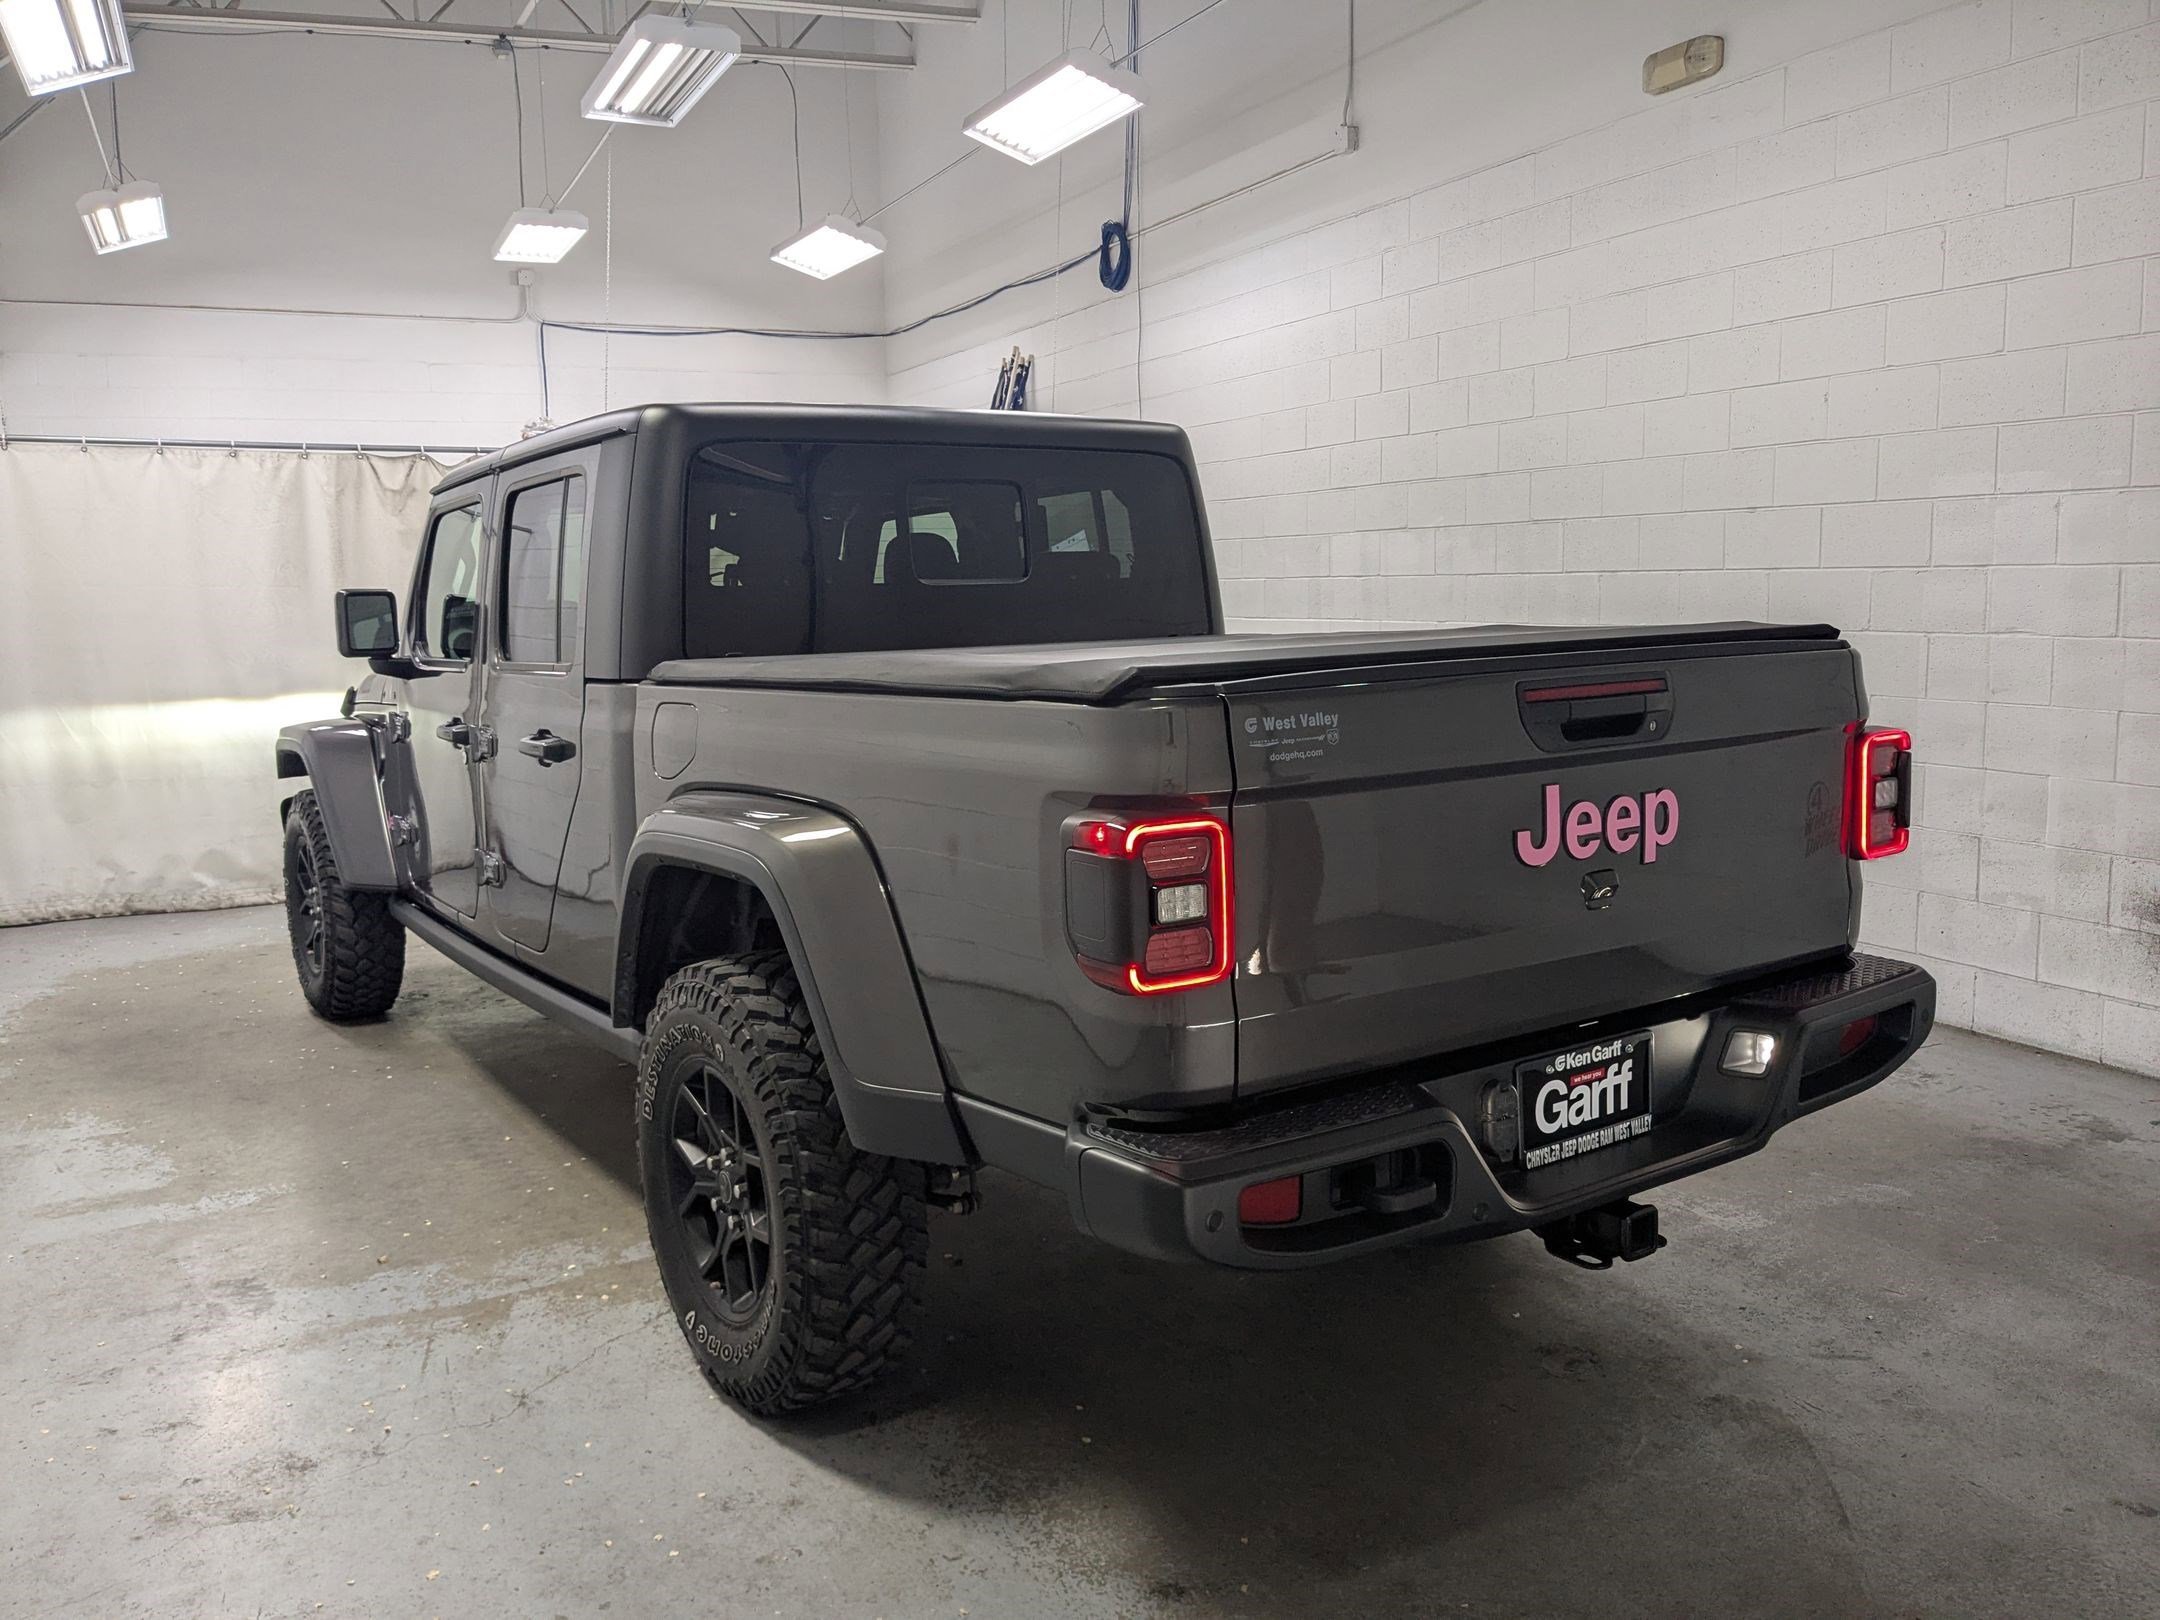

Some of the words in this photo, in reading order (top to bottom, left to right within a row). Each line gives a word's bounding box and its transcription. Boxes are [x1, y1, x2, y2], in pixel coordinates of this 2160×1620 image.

[1262, 715, 1296, 731] West
[1299, 712, 1338, 727] Valley
[1269, 749, 1324, 761] dodgehq.com
[1514, 783, 1680, 867] Jeep
[642, 1023, 714, 1121] DESTINATION
[1566, 1051, 1591, 1070] Ken
[1591, 1039, 1623, 1062] Garff
[1535, 1059, 1632, 1134] Garff
[1573, 1075, 1582, 1083] we
[1581, 1072, 1593, 1081] hear
[1592, 1070, 1602, 1079] you
[1526, 1144, 1561, 1169] CHRYSLER
[1561, 1139, 1577, 1159] JEEP
[1577, 1131, 1599, 1154] DODGE
[1600, 1125, 1614, 1147] RAM
[1614, 1122, 1631, 1141] WEST
[1630, 1114, 1652, 1137] VALLEY
